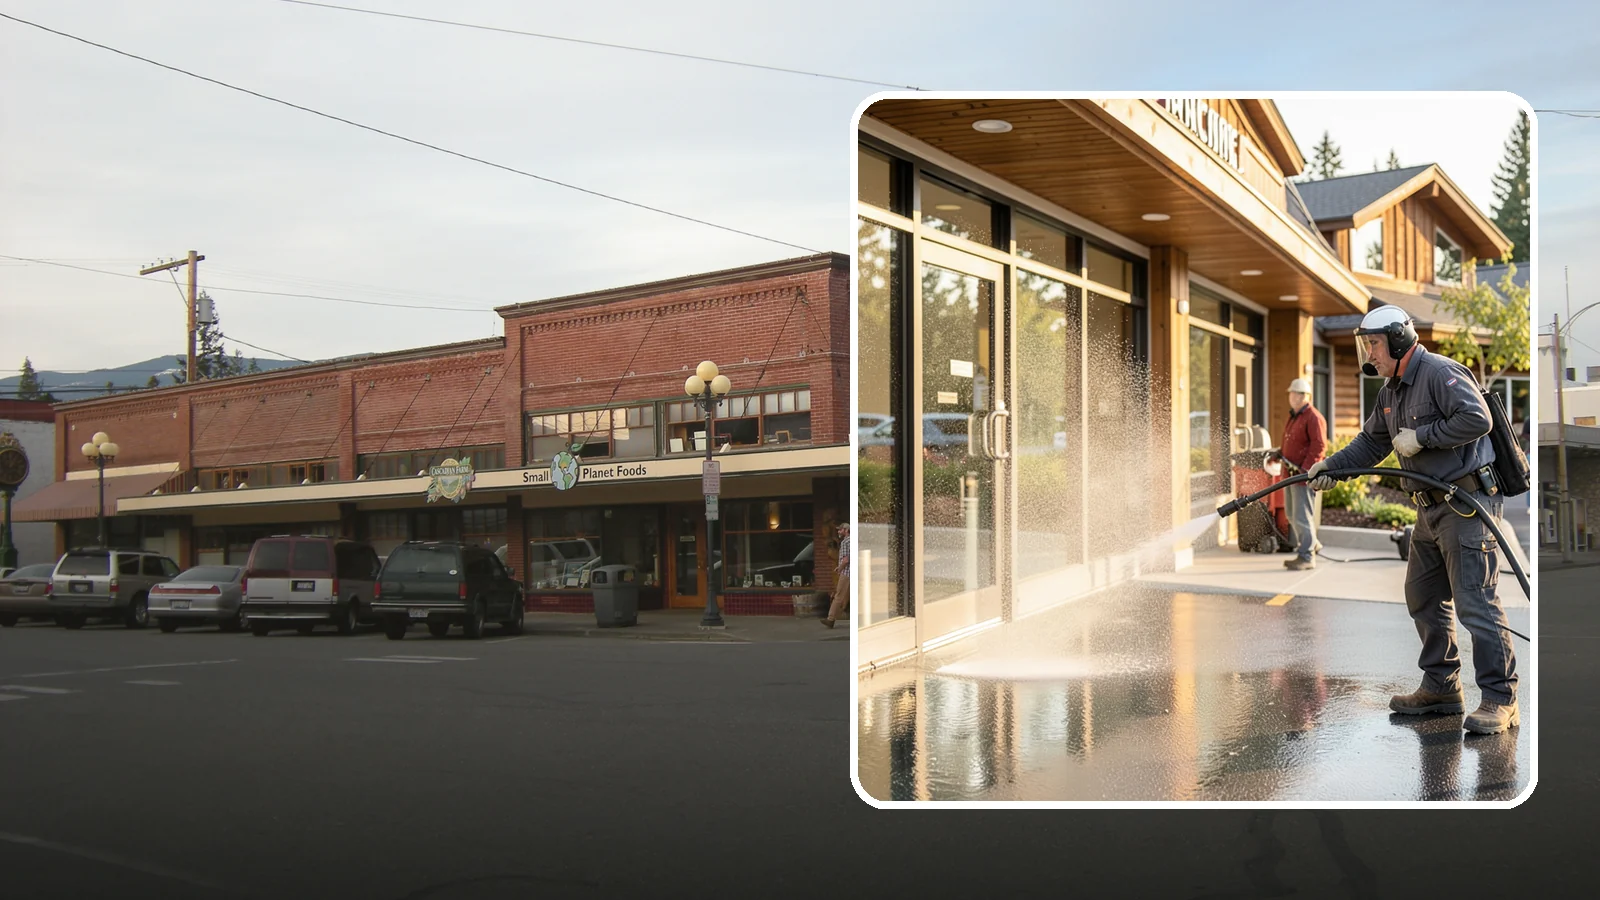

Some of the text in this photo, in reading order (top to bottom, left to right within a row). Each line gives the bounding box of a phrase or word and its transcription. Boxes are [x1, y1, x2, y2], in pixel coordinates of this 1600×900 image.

[523, 464, 647, 483] Small Planet Foods
